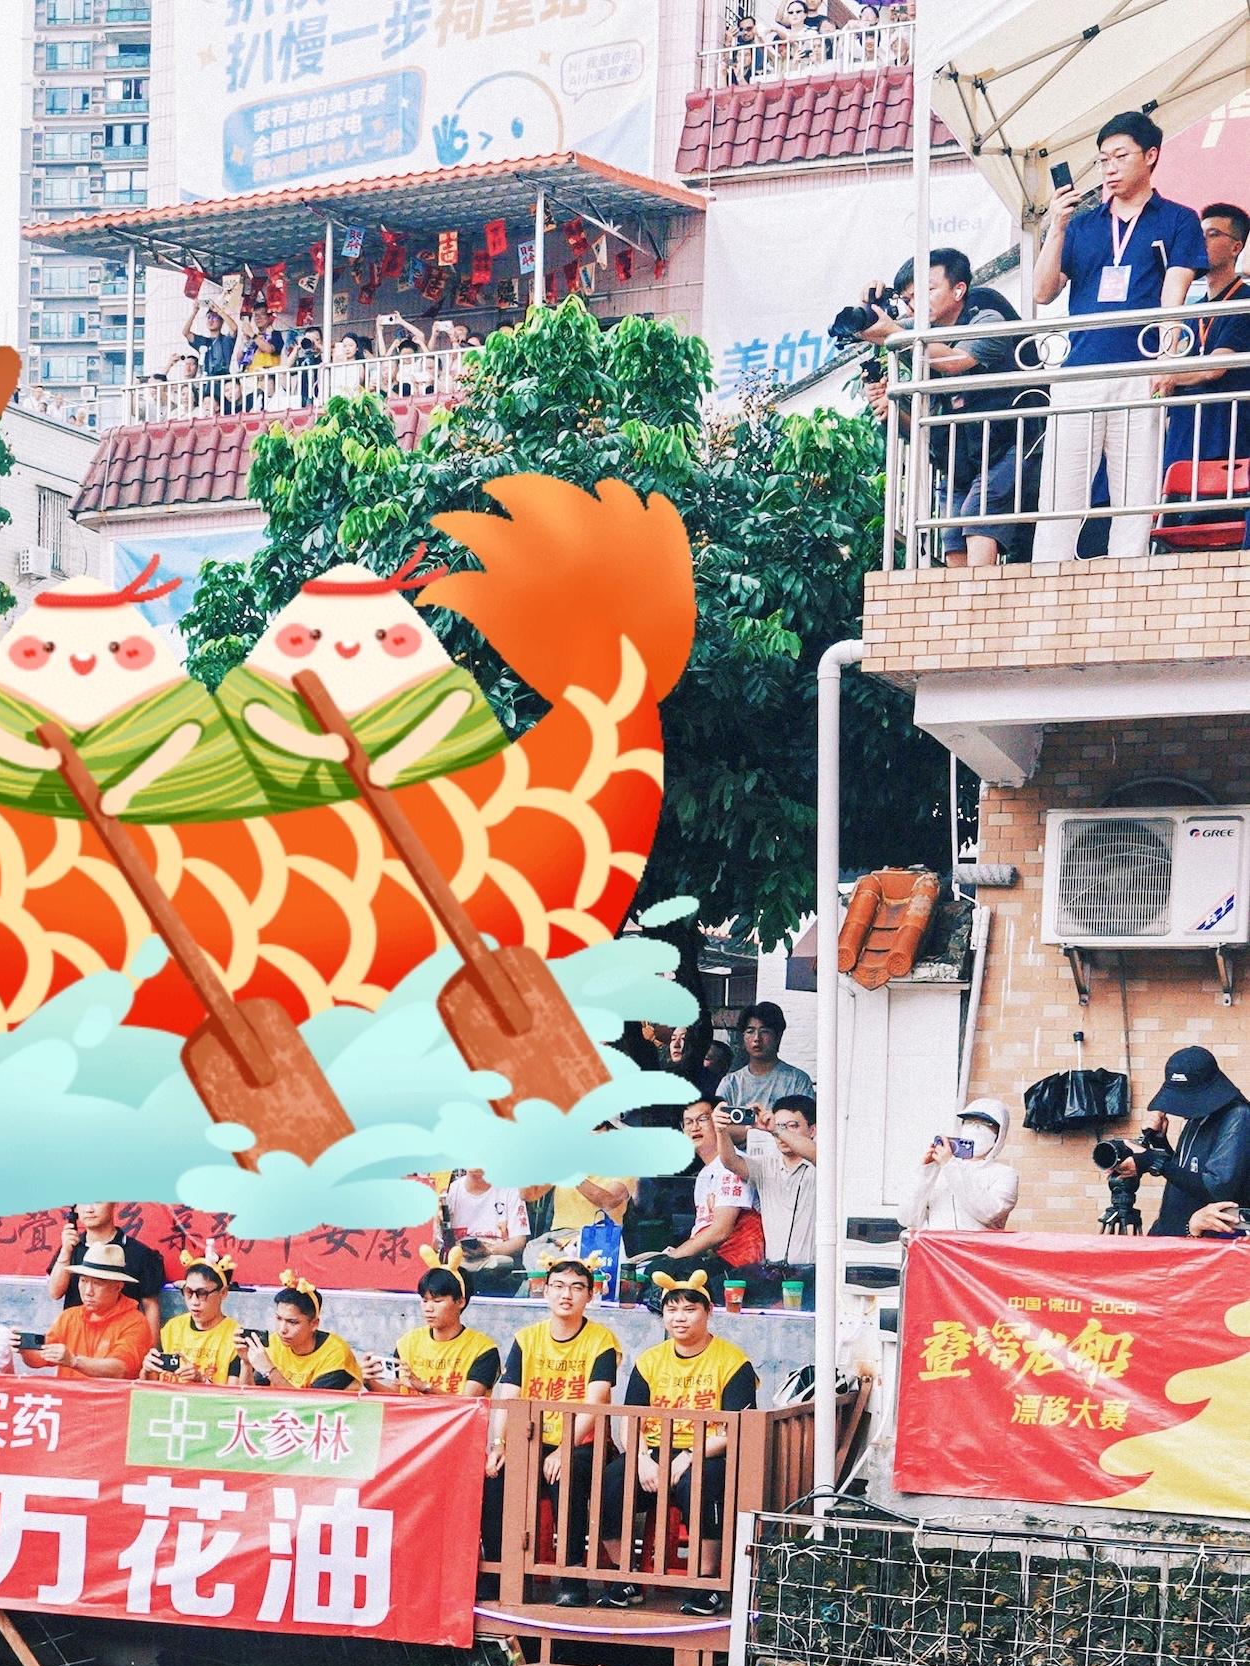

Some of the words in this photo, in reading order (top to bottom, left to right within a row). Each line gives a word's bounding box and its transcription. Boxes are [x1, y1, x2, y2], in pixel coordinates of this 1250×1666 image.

[717, 329, 847, 401] 美的
[1202, 829, 1235, 838] GREE
[1091, 1300, 1137, 1315] 2026
[1011, 1394, 1131, 1431] 漂移大赛
[215, 1408, 352, 1463] 大参林
